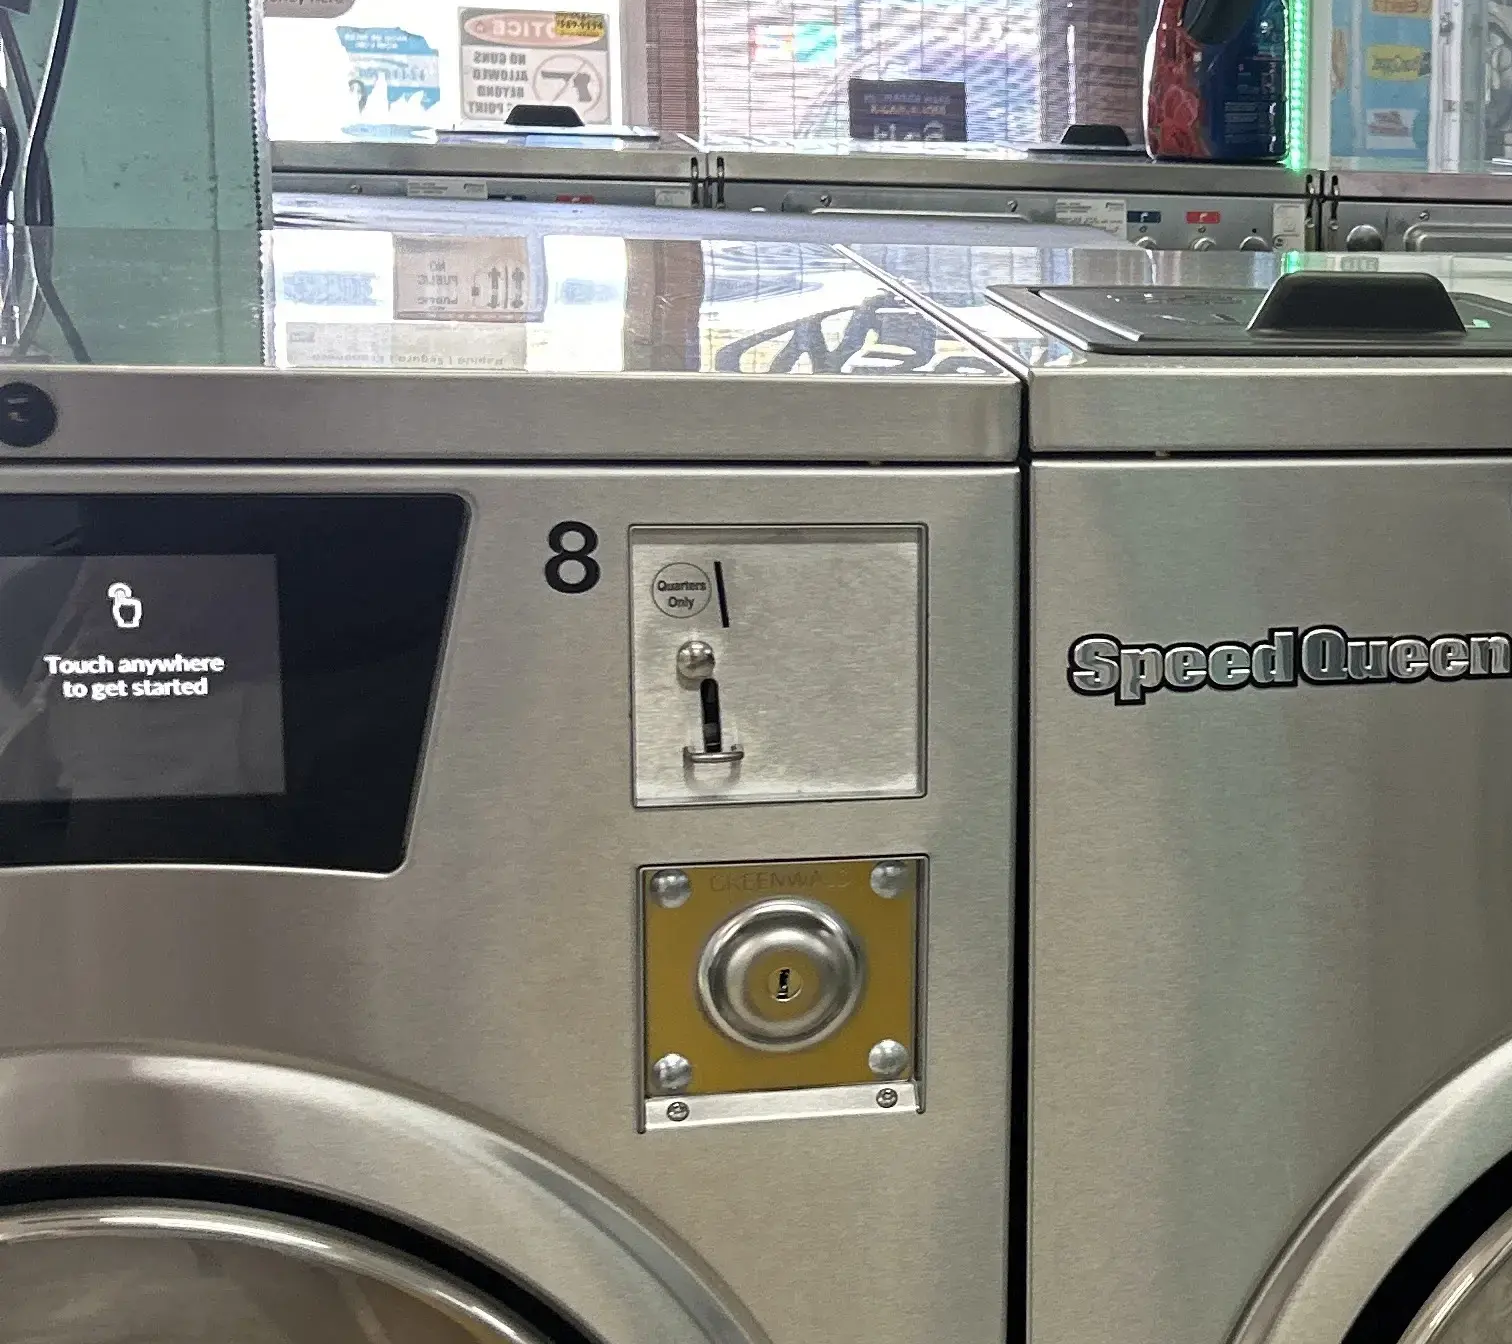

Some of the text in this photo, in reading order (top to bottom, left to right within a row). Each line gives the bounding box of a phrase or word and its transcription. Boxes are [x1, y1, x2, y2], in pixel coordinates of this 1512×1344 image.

[544, 520, 601, 595] 8
[656, 579, 707, 593] Quarters
[667, 594, 695, 611] Only
[43, 652, 226, 676] Touch anywhere
[1066, 626, 1298, 706] Speed
[62, 676, 210, 701] to get started
